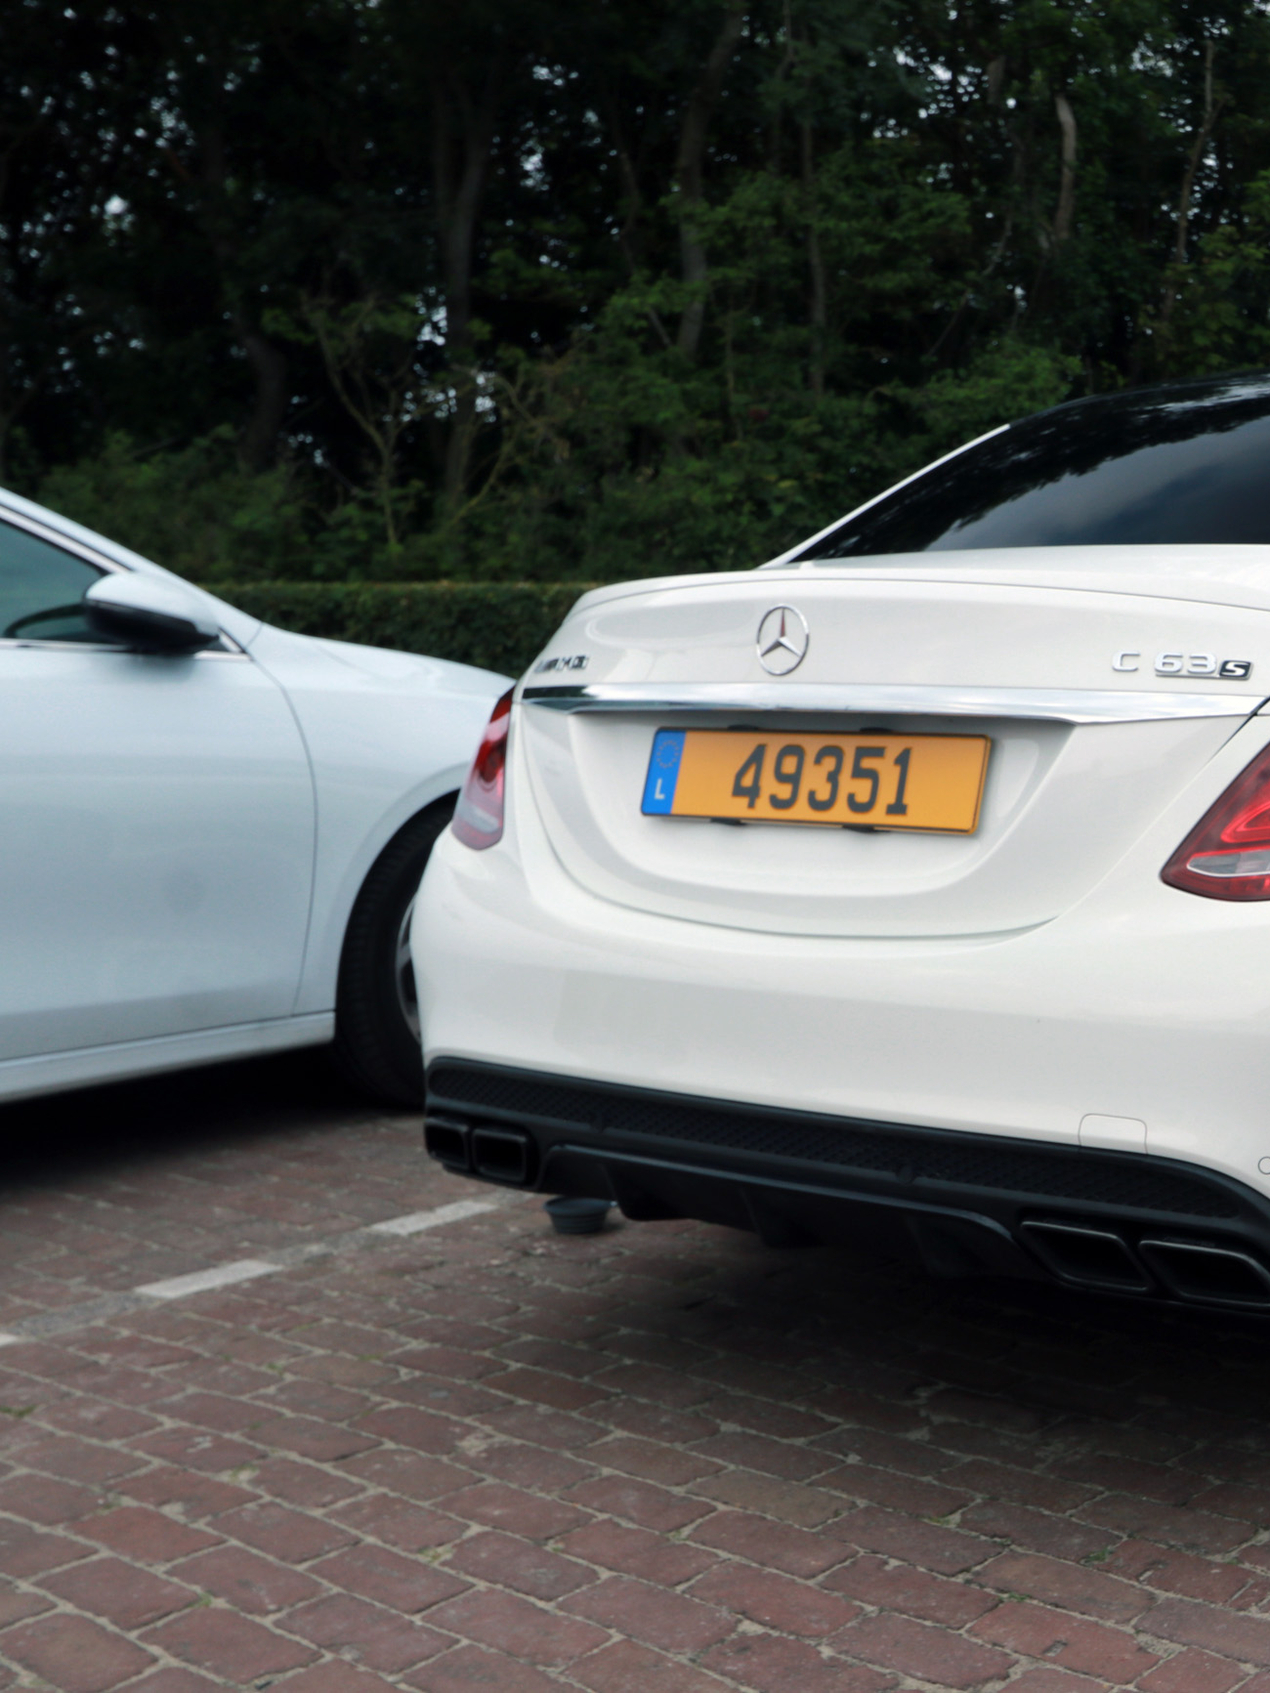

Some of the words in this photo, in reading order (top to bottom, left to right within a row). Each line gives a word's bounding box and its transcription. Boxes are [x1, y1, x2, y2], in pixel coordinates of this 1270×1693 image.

[1112, 652, 1140, 672] C
[654, 778, 665, 799] L
[731, 743, 913, 816] 49351
